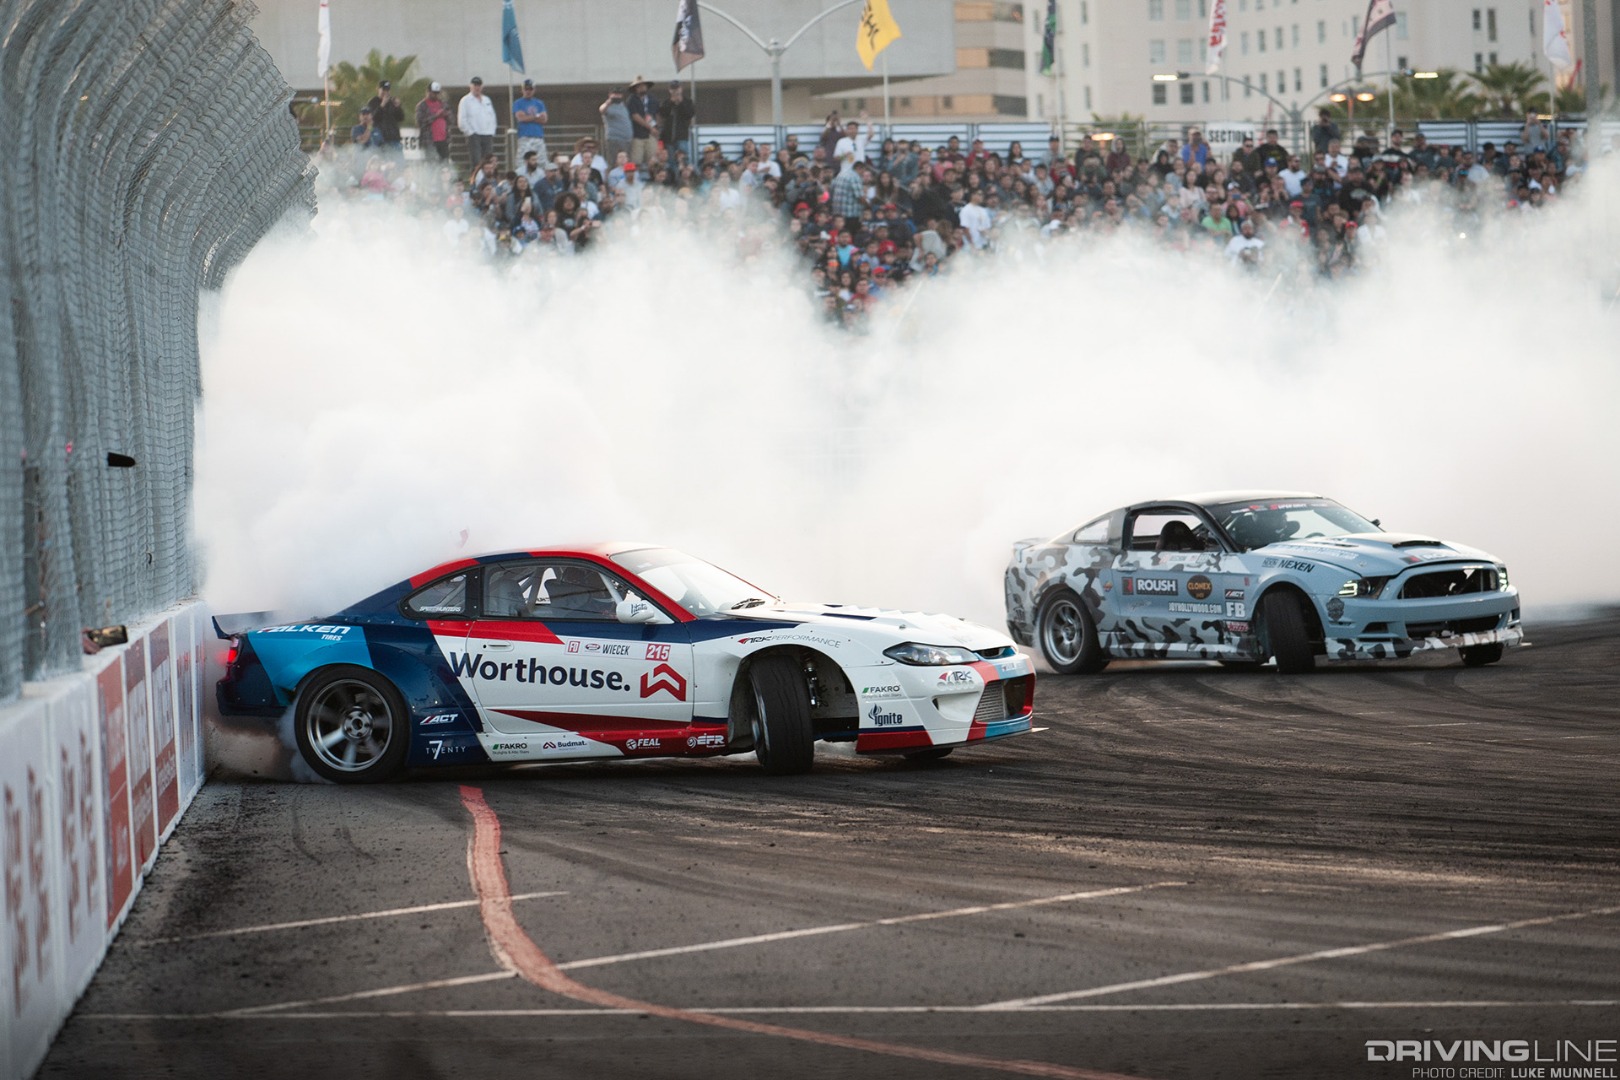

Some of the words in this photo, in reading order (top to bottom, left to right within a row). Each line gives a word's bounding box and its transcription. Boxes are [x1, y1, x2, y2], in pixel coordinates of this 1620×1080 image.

[1278, 560, 1315, 573] NEXEN
[1137, 579, 1176, 592] ROUSH
[1187, 582, 1211, 591] CLONEX
[1226, 602, 1246, 617] FB
[257, 625, 351, 634] FALKEN
[321, 633, 342, 641] TIRES
[771, 634, 841, 648] PERFORMANCE
[602, 644, 630, 655] WIECEK
[646, 644, 669, 660] 215
[874, 712, 903, 727] ignite
[637, 738, 661, 746] FEAL
